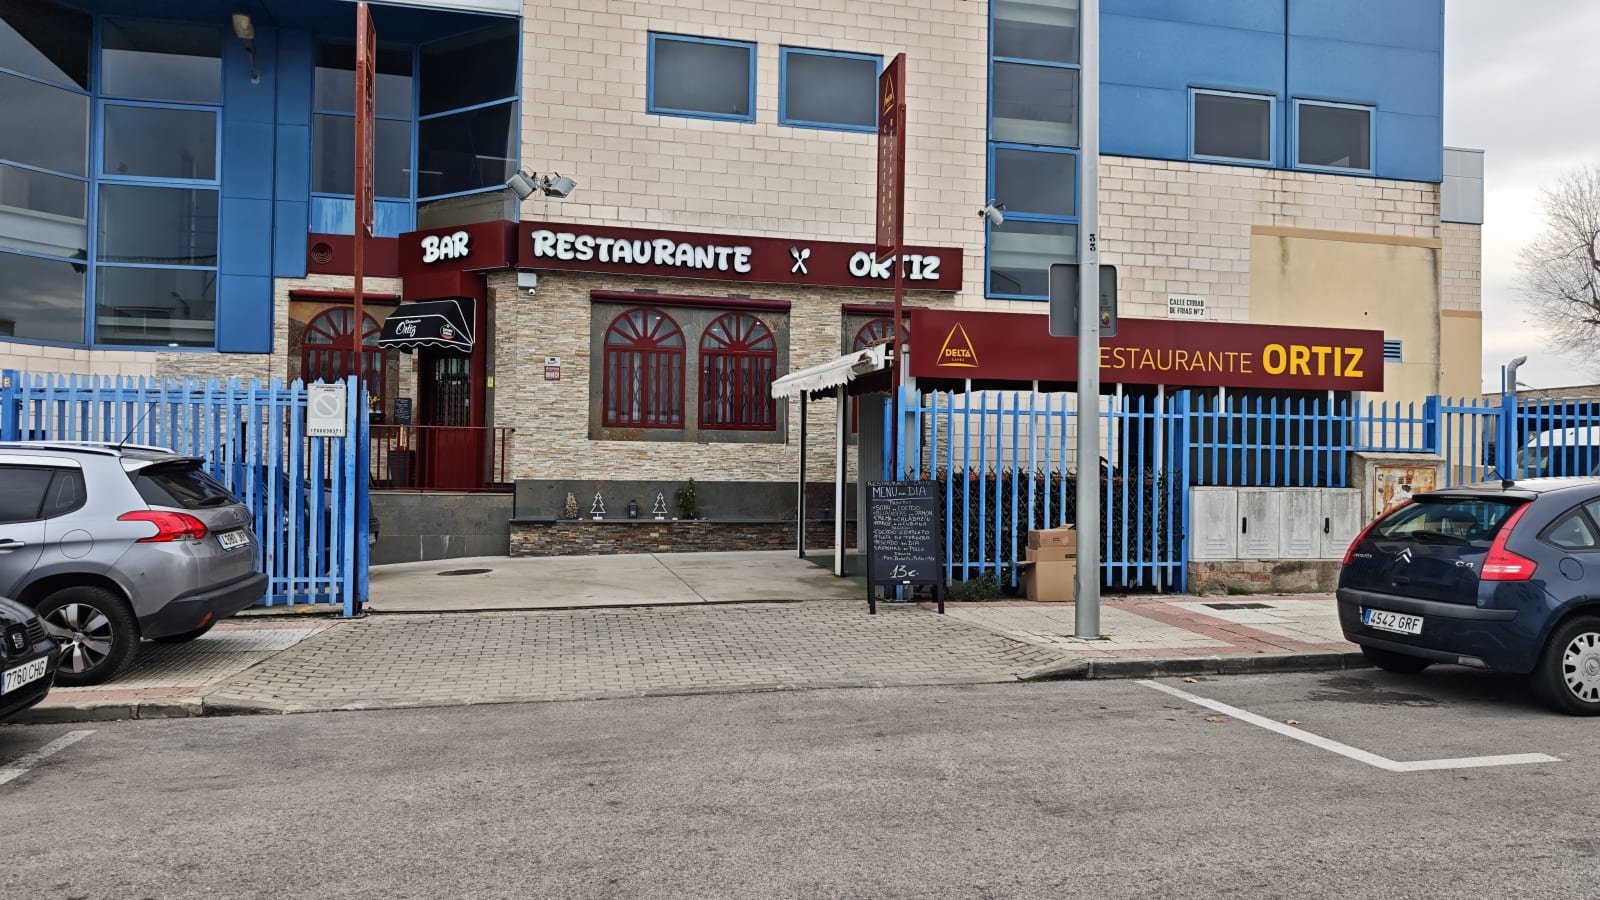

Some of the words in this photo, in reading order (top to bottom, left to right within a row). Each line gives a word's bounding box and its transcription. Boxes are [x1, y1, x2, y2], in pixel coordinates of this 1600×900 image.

[421, 230, 469, 263] BAR
[532, 229, 752, 273] RESTAURANTE
[1169, 298, 1185, 306] CALLE
[1169, 306, 1176, 314] DE
[945, 348, 972, 358] DELTA
[1097, 346, 1253, 373] ESTAURANTE
[1262, 343, 1364, 378] ORTIZ
[1455, 560, 1474, 569] C4
[1370, 611, 1395, 628] 4542
[1397, 616, 1421, 631] GRF
[6, 667, 27, 690] 7760
[28, 660, 45, 680] CHG
